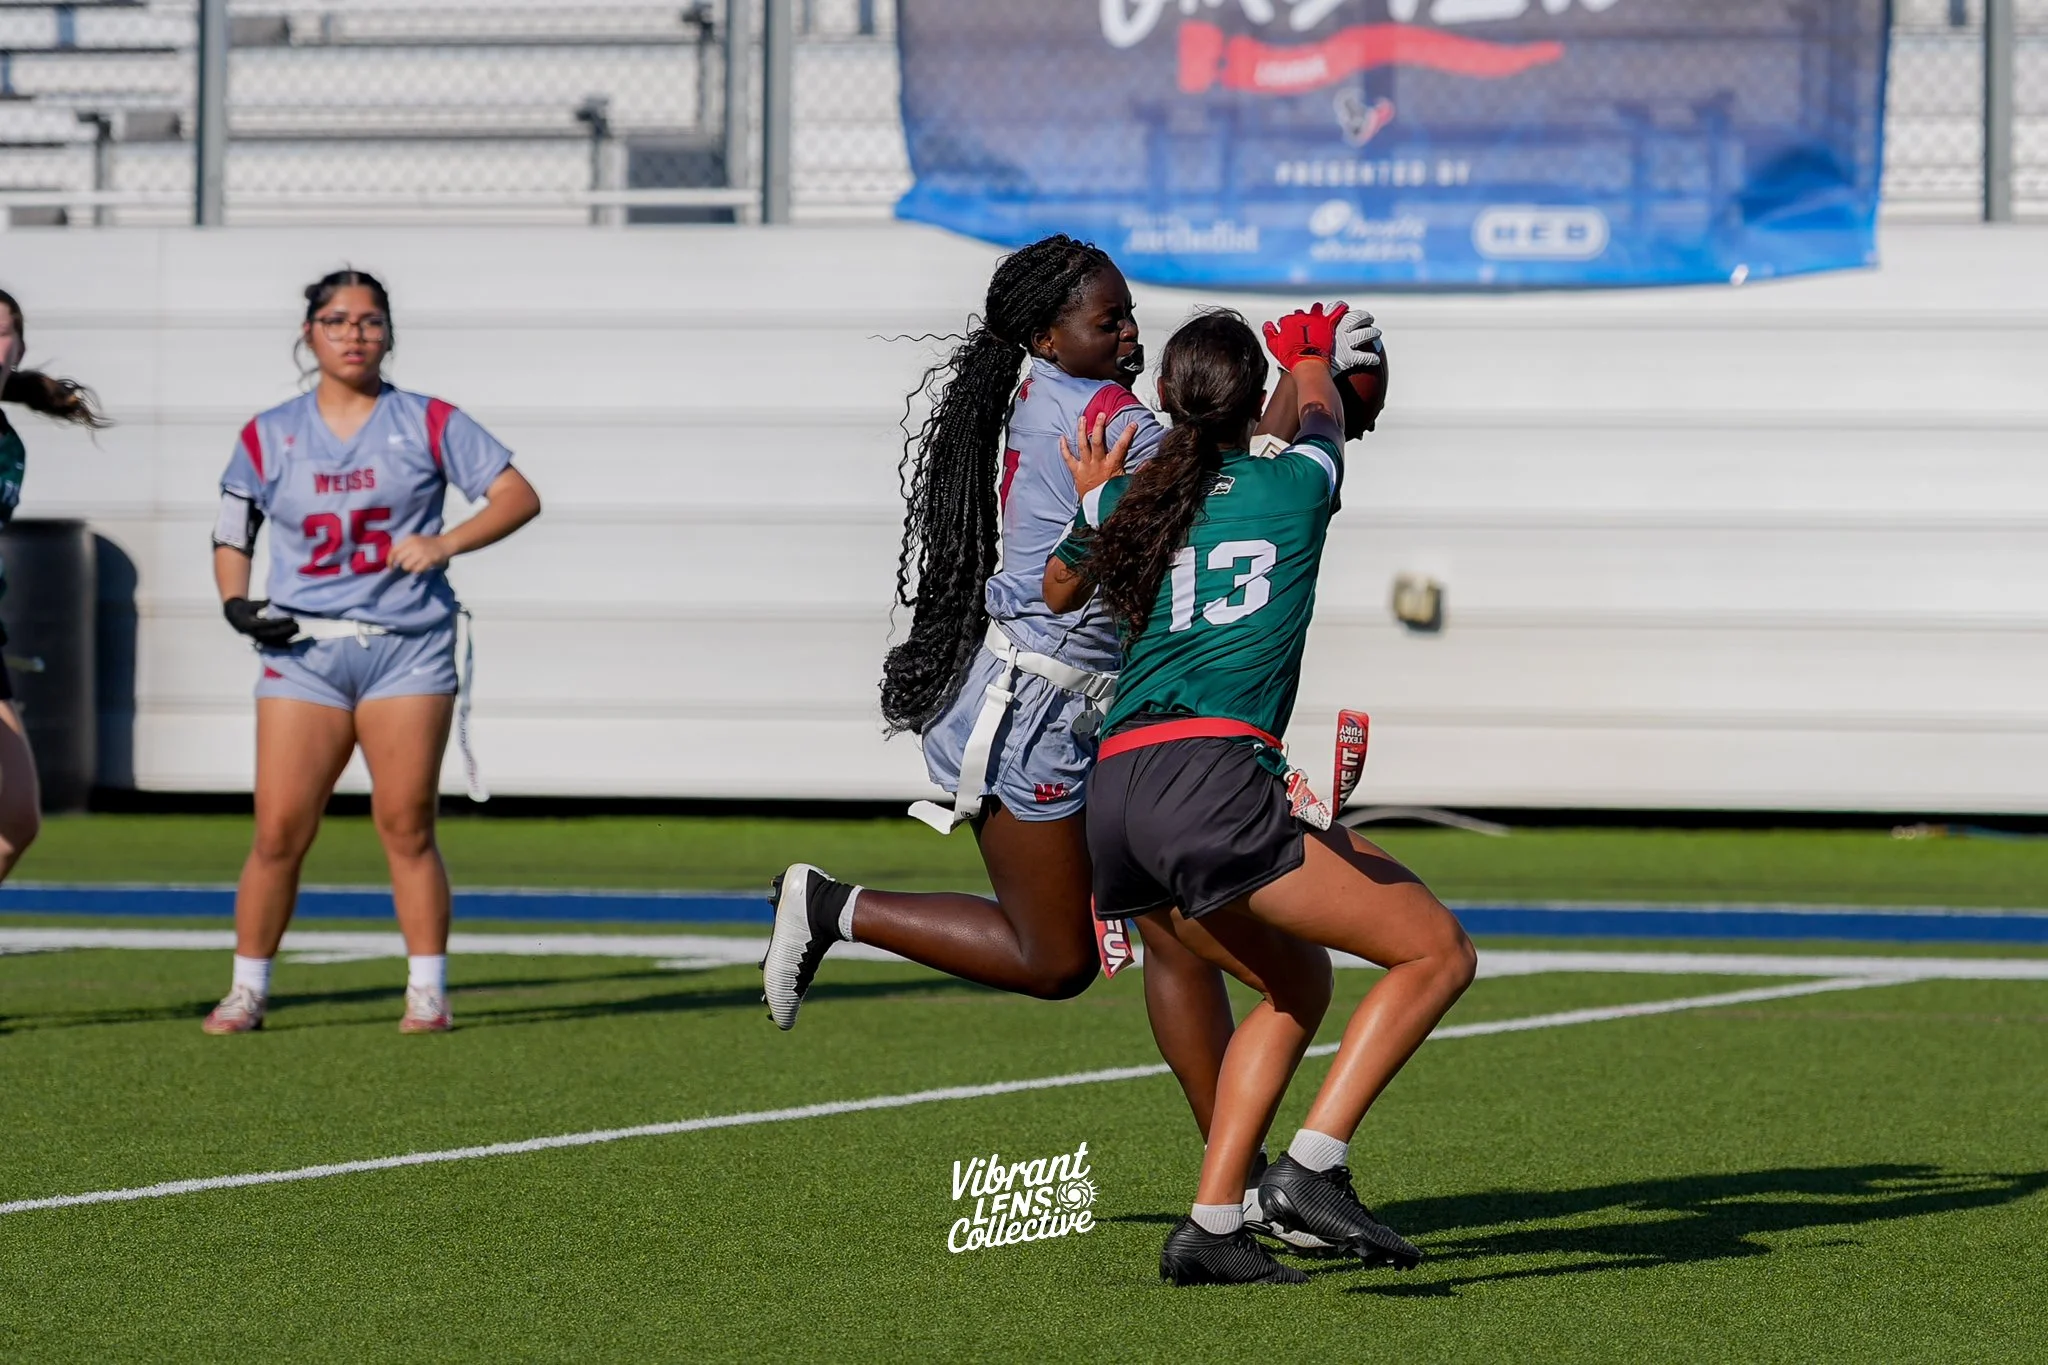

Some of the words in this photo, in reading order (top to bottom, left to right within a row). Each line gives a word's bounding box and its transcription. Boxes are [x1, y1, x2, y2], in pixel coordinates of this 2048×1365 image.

[313, 468, 376, 494] WEISS
[297, 507, 393, 578] 25
[1168, 538, 1278, 633] 13
[1339, 725, 1364, 737] FURY
[1339, 734, 1364, 744] TEXAS
[1341, 747, 1359, 766] IT
